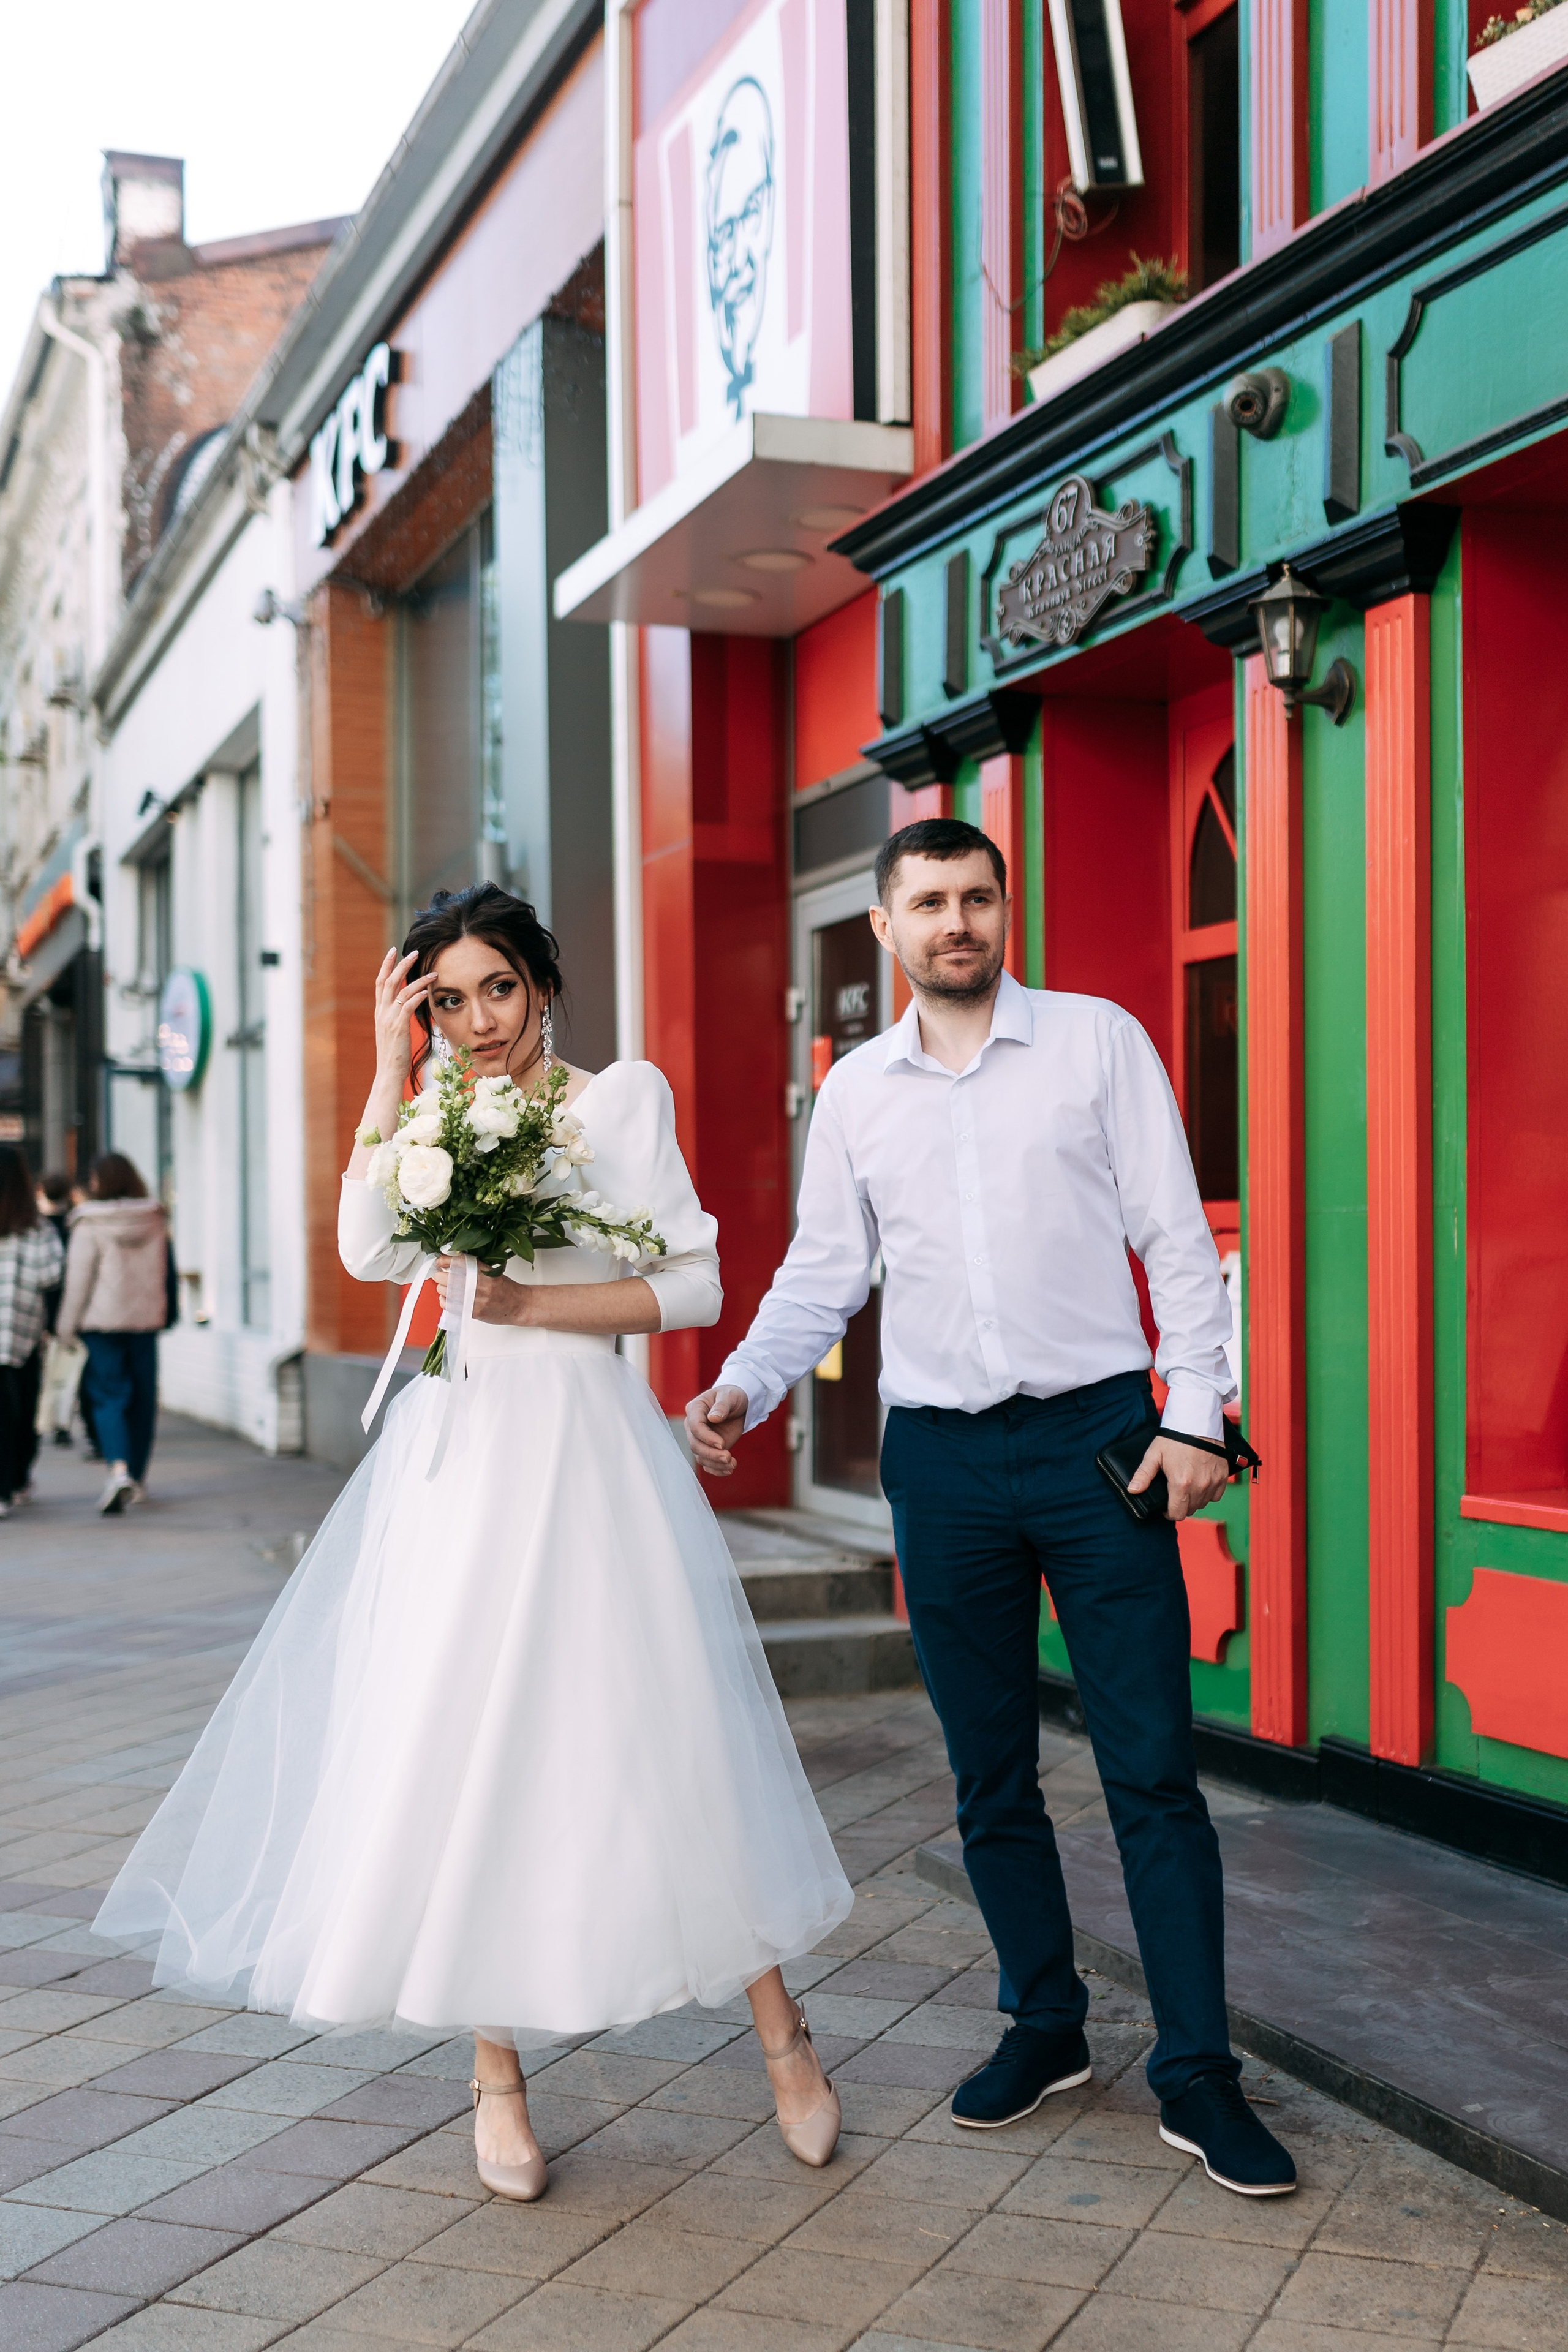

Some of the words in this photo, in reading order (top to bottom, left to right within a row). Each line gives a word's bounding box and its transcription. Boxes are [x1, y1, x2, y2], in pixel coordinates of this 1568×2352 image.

[309, 342, 390, 549] KFC
[1052, 486, 1078, 533] 67
[1019, 532, 1115, 603] КРАСНАЯ
[1074, 565, 1107, 594] Street
[839, 982, 869, 1019] KFC
